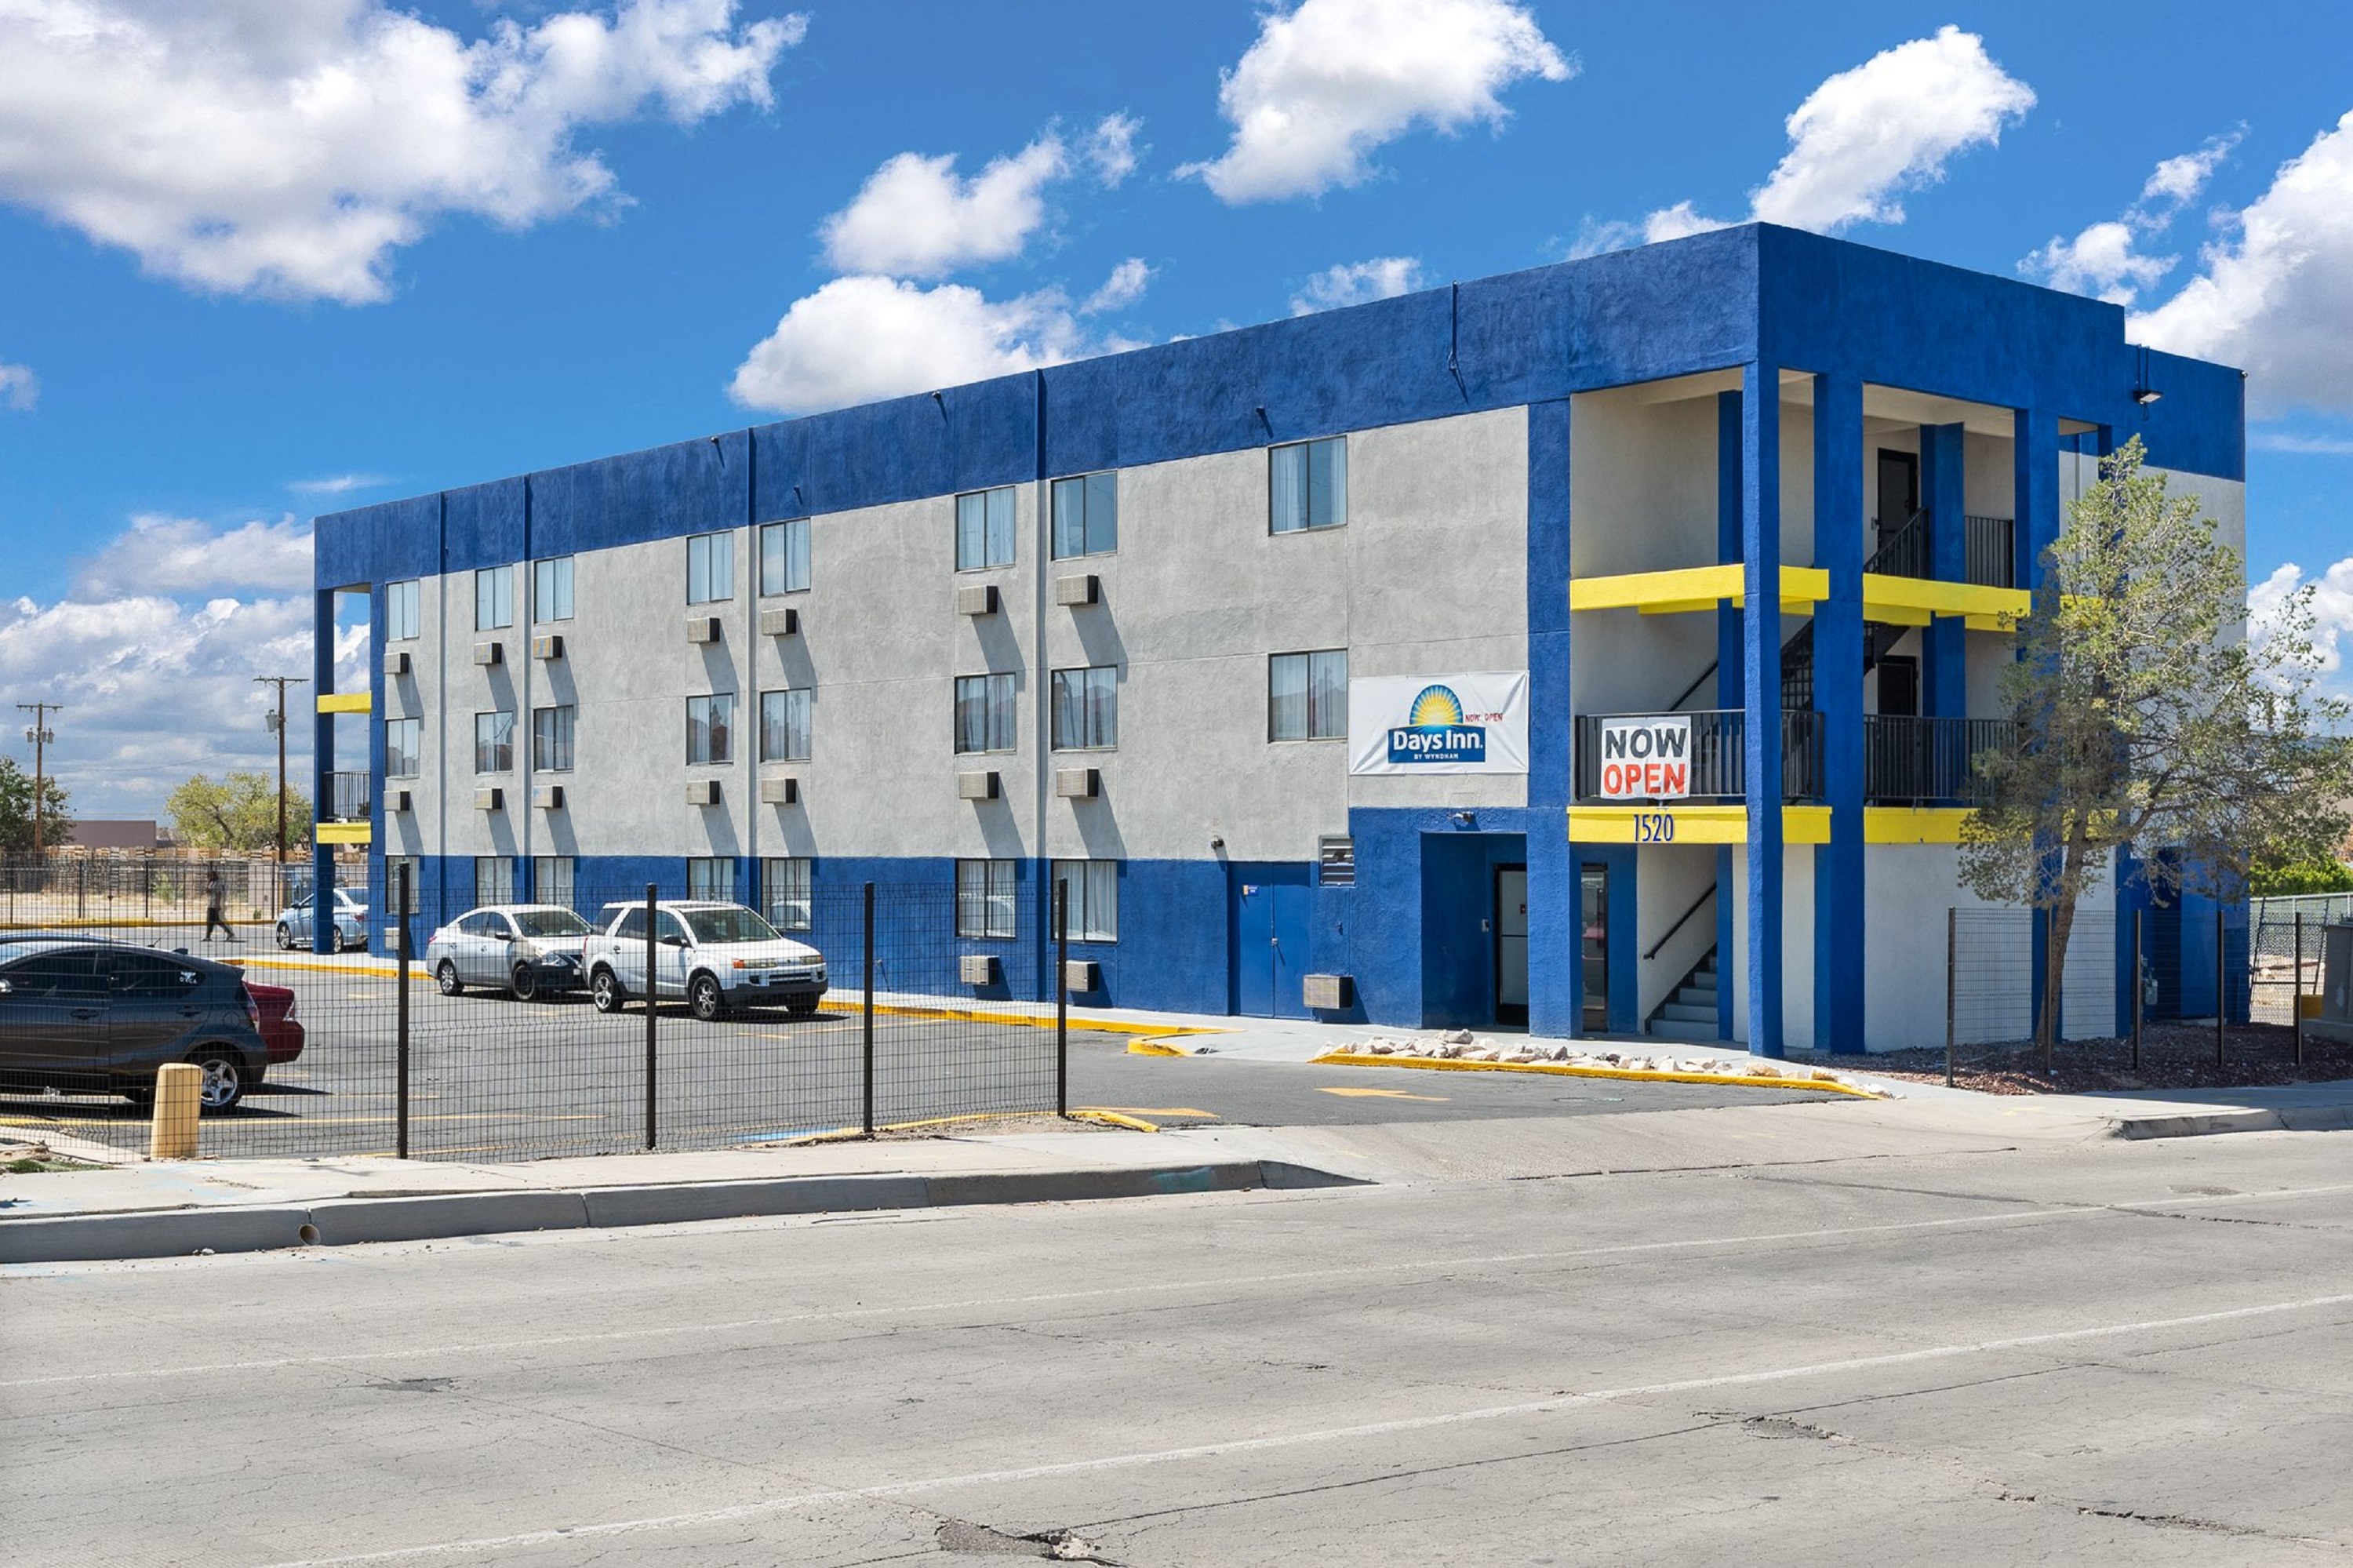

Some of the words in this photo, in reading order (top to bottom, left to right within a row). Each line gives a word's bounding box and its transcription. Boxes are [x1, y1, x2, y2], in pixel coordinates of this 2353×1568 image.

[1464, 713, 1481, 722] NOW
[1484, 712, 1503, 722] OPEN
[1394, 731, 1443, 753] Days
[1606, 728, 1686, 759] NOW
[1604, 763, 1686, 795] OPEN
[1634, 813, 1675, 842] 1520
